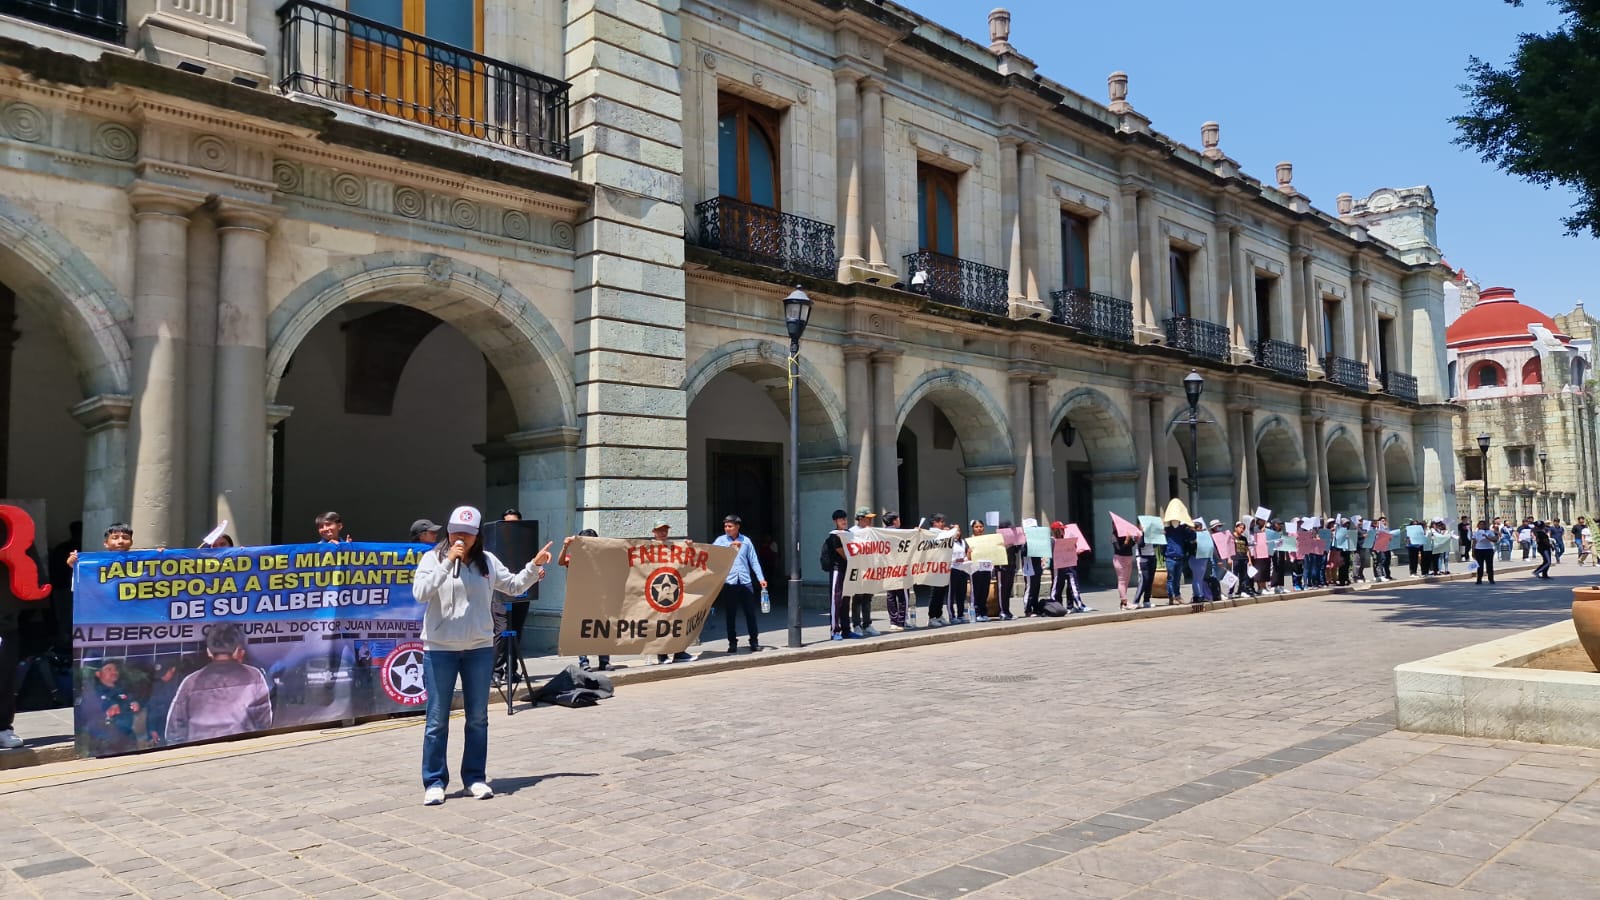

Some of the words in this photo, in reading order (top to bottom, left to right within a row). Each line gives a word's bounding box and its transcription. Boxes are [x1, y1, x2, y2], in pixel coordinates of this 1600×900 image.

[628, 544, 709, 571] FNERRR
[897, 539, 911, 553] SE
[99, 556, 252, 583] ¡AUTORIDAD
[259, 555, 288, 571] DE
[119, 577, 237, 601] DESPOJA
[244, 575, 261, 592] A
[170, 600, 205, 620] DE
[213, 596, 249, 616] SU
[256, 588, 389, 612] ALBERGUE!
[73, 624, 194, 642] ALBERGUE
[201, 621, 284, 636] CTURAL
[345, 621, 372, 631] JUAN
[376, 620, 420, 632] MANUEL
[580, 619, 611, 639] EN
[616, 619, 649, 640] PIE
[655, 619, 683, 638] DE
